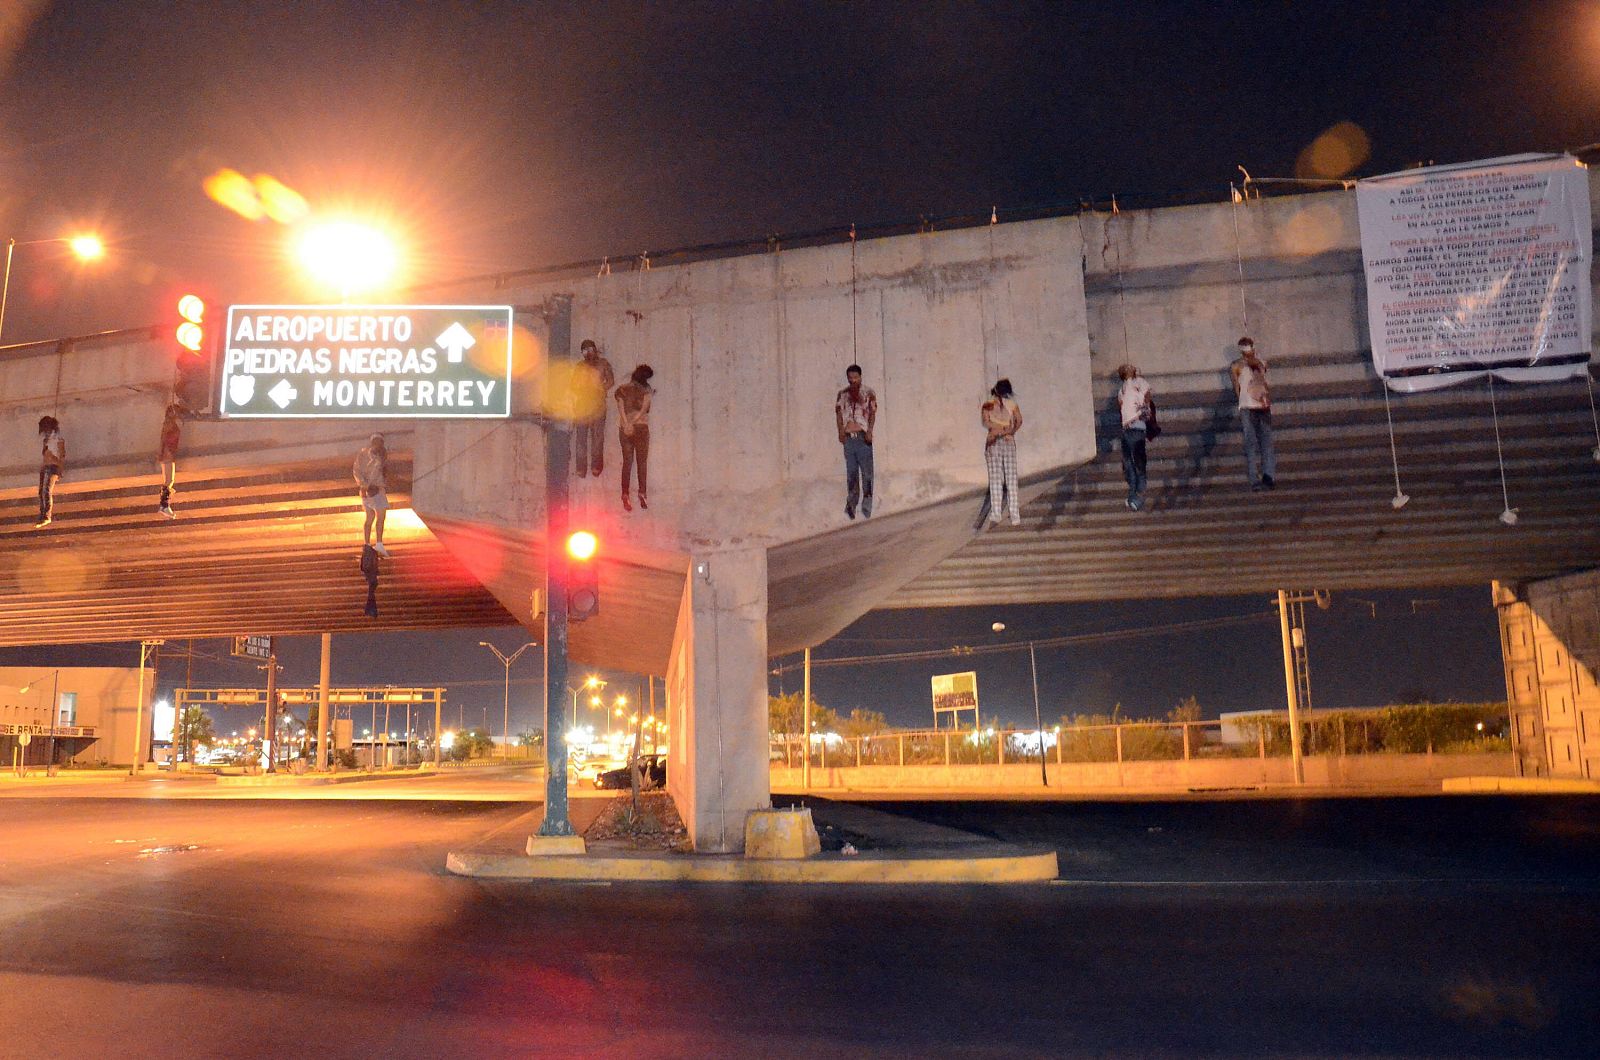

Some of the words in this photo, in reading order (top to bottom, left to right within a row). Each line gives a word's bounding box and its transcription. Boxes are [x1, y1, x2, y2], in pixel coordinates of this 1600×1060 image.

[235, 315, 412, 342] AEROPUERTO
[228, 348, 331, 374] PIEDRAS
[338, 348, 438, 374] NEGRAS
[313, 380, 496, 407] MONTERREY
[18, 725, 43, 734] RENTA
